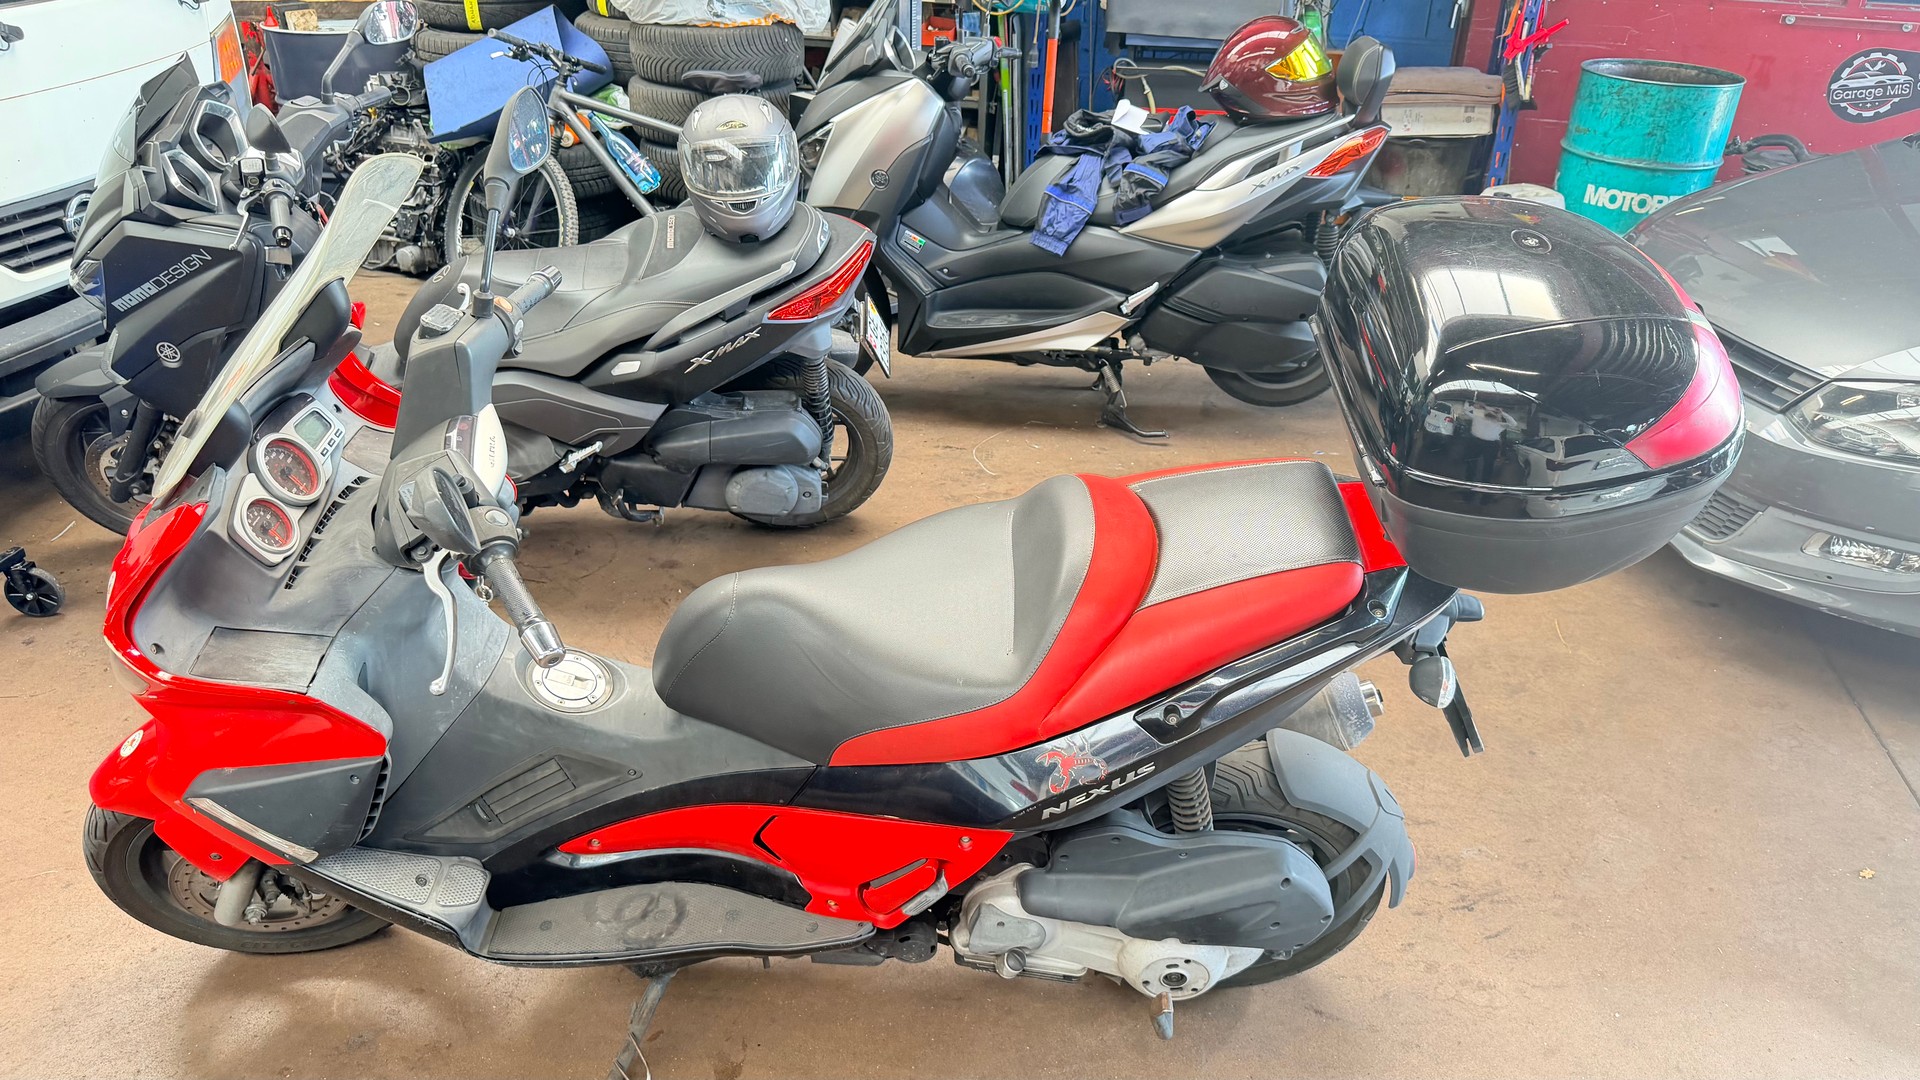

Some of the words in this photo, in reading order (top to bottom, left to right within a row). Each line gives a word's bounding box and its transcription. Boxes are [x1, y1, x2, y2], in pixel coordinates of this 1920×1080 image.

[1833, 88, 1884, 101] Garage
[1886, 84, 1910, 96] MIS
[1583, 183, 1683, 214] MOTOR
[1041, 761, 1156, 820] NEXUS
